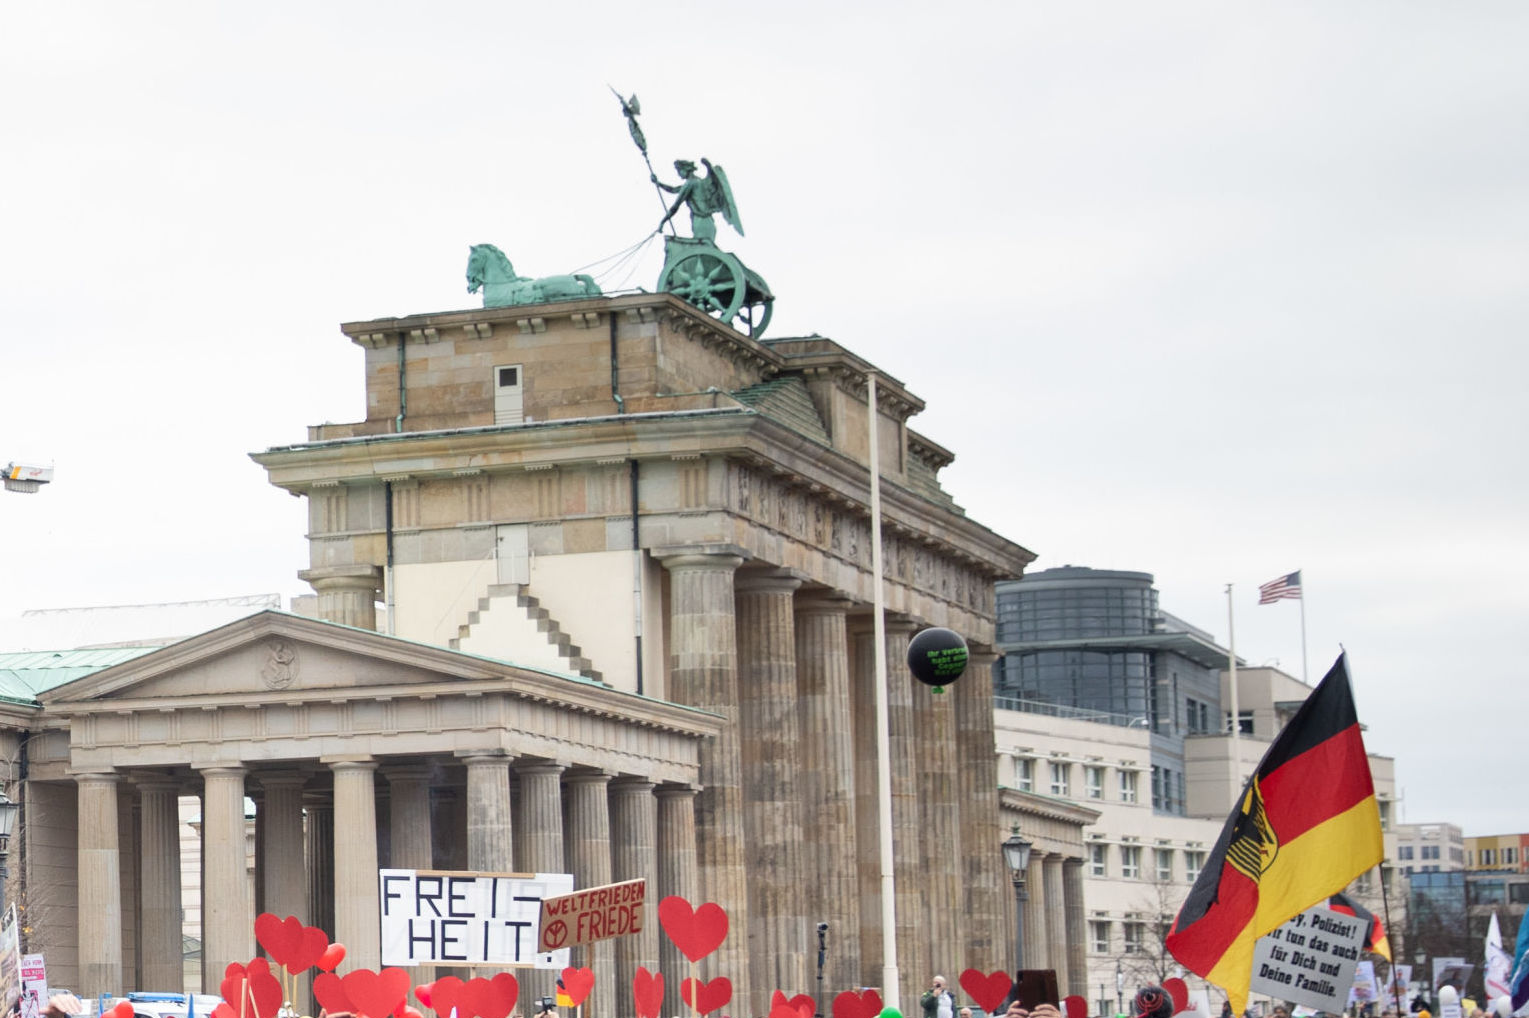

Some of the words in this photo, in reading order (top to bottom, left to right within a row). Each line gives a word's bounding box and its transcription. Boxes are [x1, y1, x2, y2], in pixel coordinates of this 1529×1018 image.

[546, 881, 645, 917] WELTFRIEDEN
[577, 902, 642, 943] FRIEDE
[1267, 928, 1283, 940] ir
[1310, 913, 1357, 940] Polizist!
[1270, 945, 1288, 962] für
[1290, 951, 1317, 971] Dich
[1319, 962, 1342, 978] und
[1285, 929, 1306, 946] tun
[1308, 935, 1329, 953] das
[1332, 944, 1359, 961] auch
[1259, 963, 1293, 985] Deine
[1294, 973, 1337, 998] Familie.
